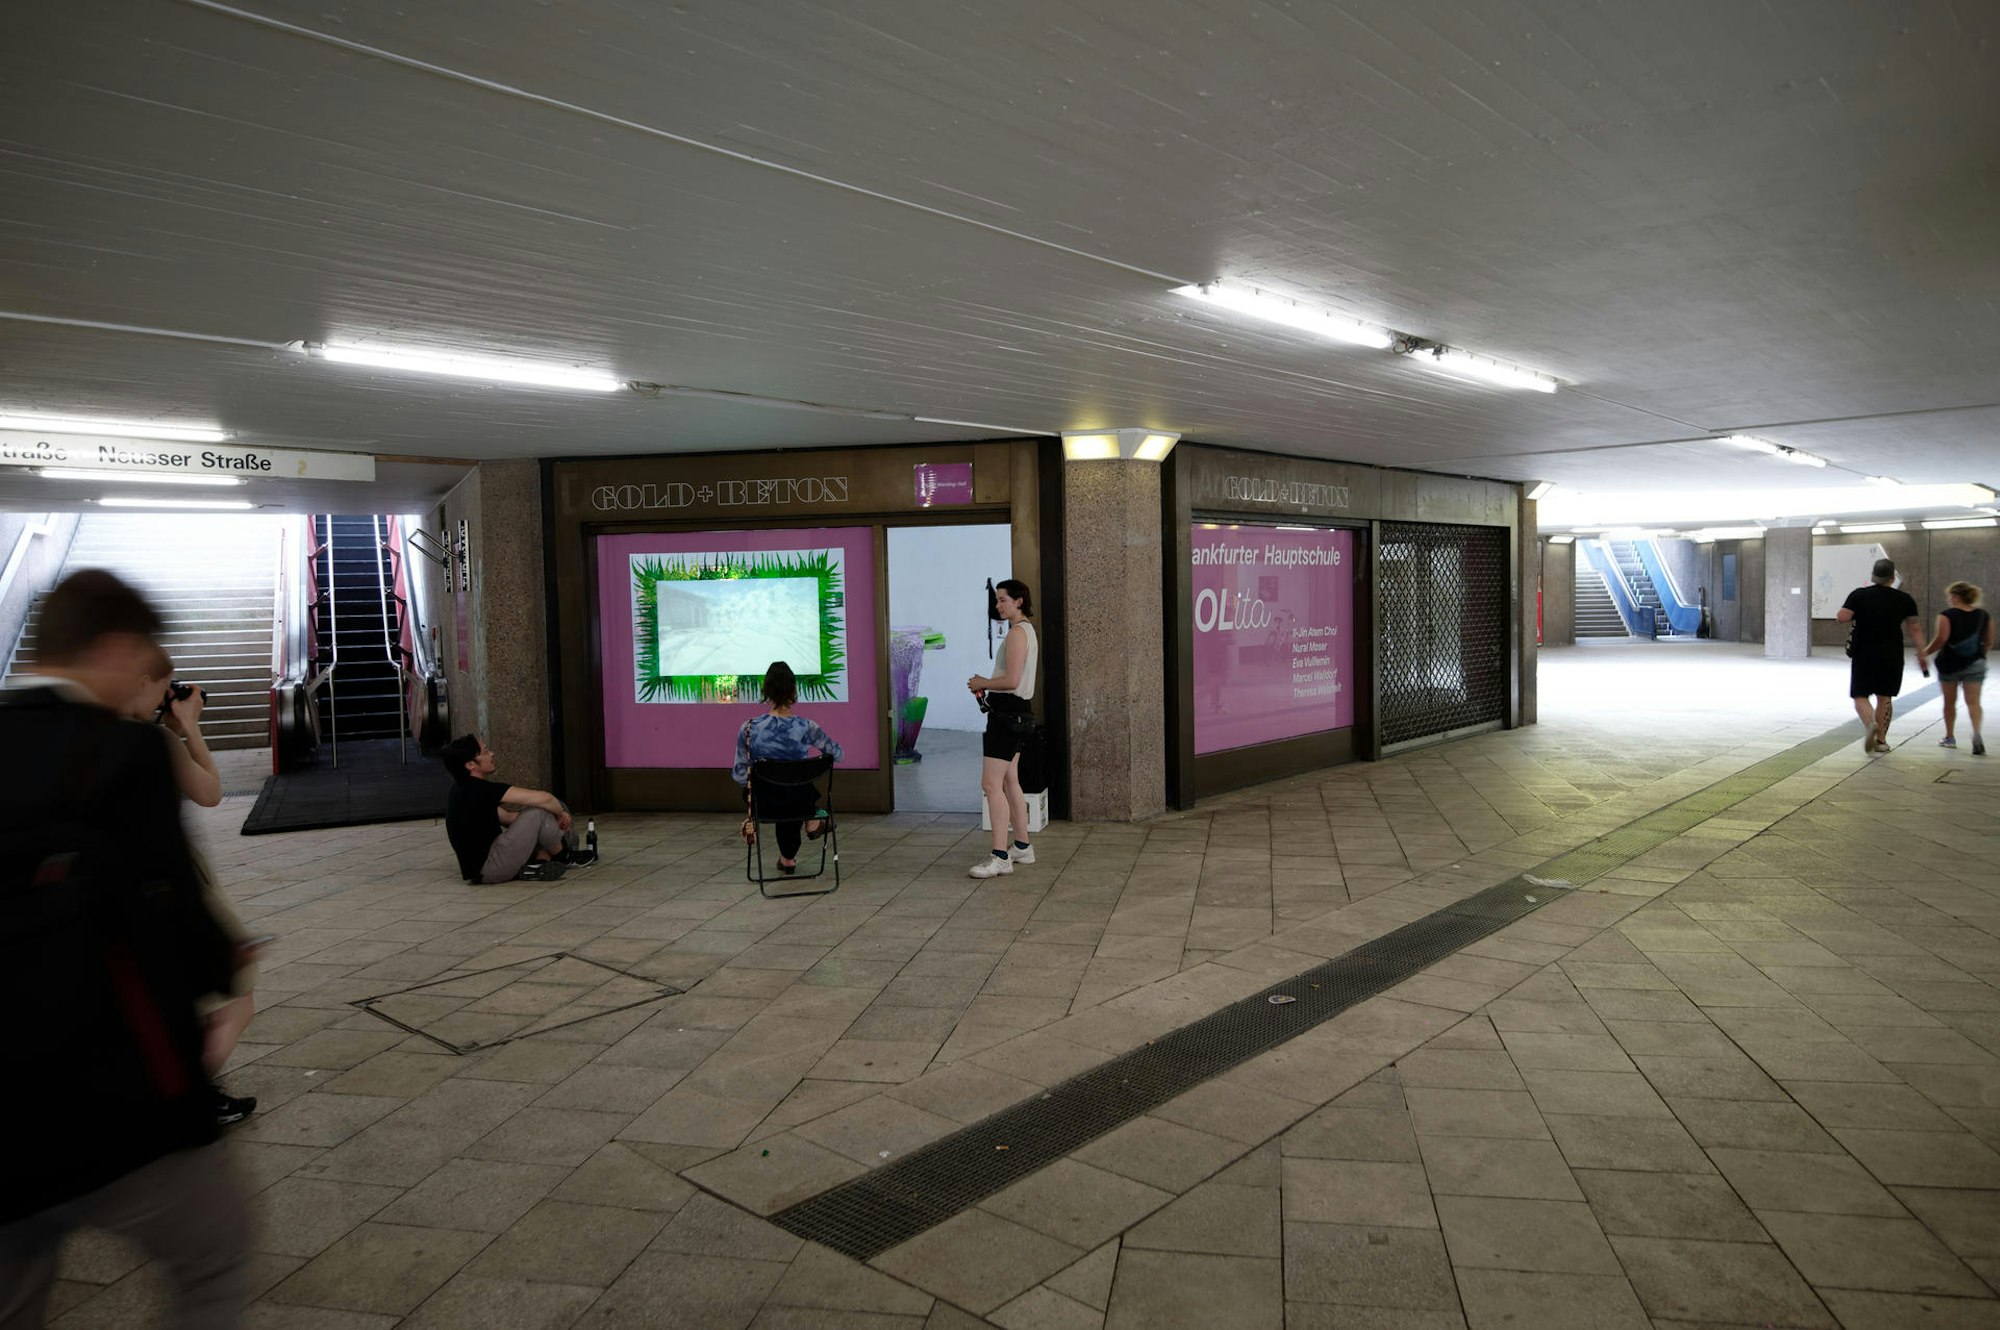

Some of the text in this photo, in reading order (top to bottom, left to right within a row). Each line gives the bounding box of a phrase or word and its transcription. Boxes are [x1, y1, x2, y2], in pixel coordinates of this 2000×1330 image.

[98, 446, 192, 467] Neusser
[201, 451, 272, 471] Straße
[1264, 544, 1341, 569] Hauptschule
[1309, 642, 1328, 652] Moser
[1292, 658, 1304, 668] Eva
